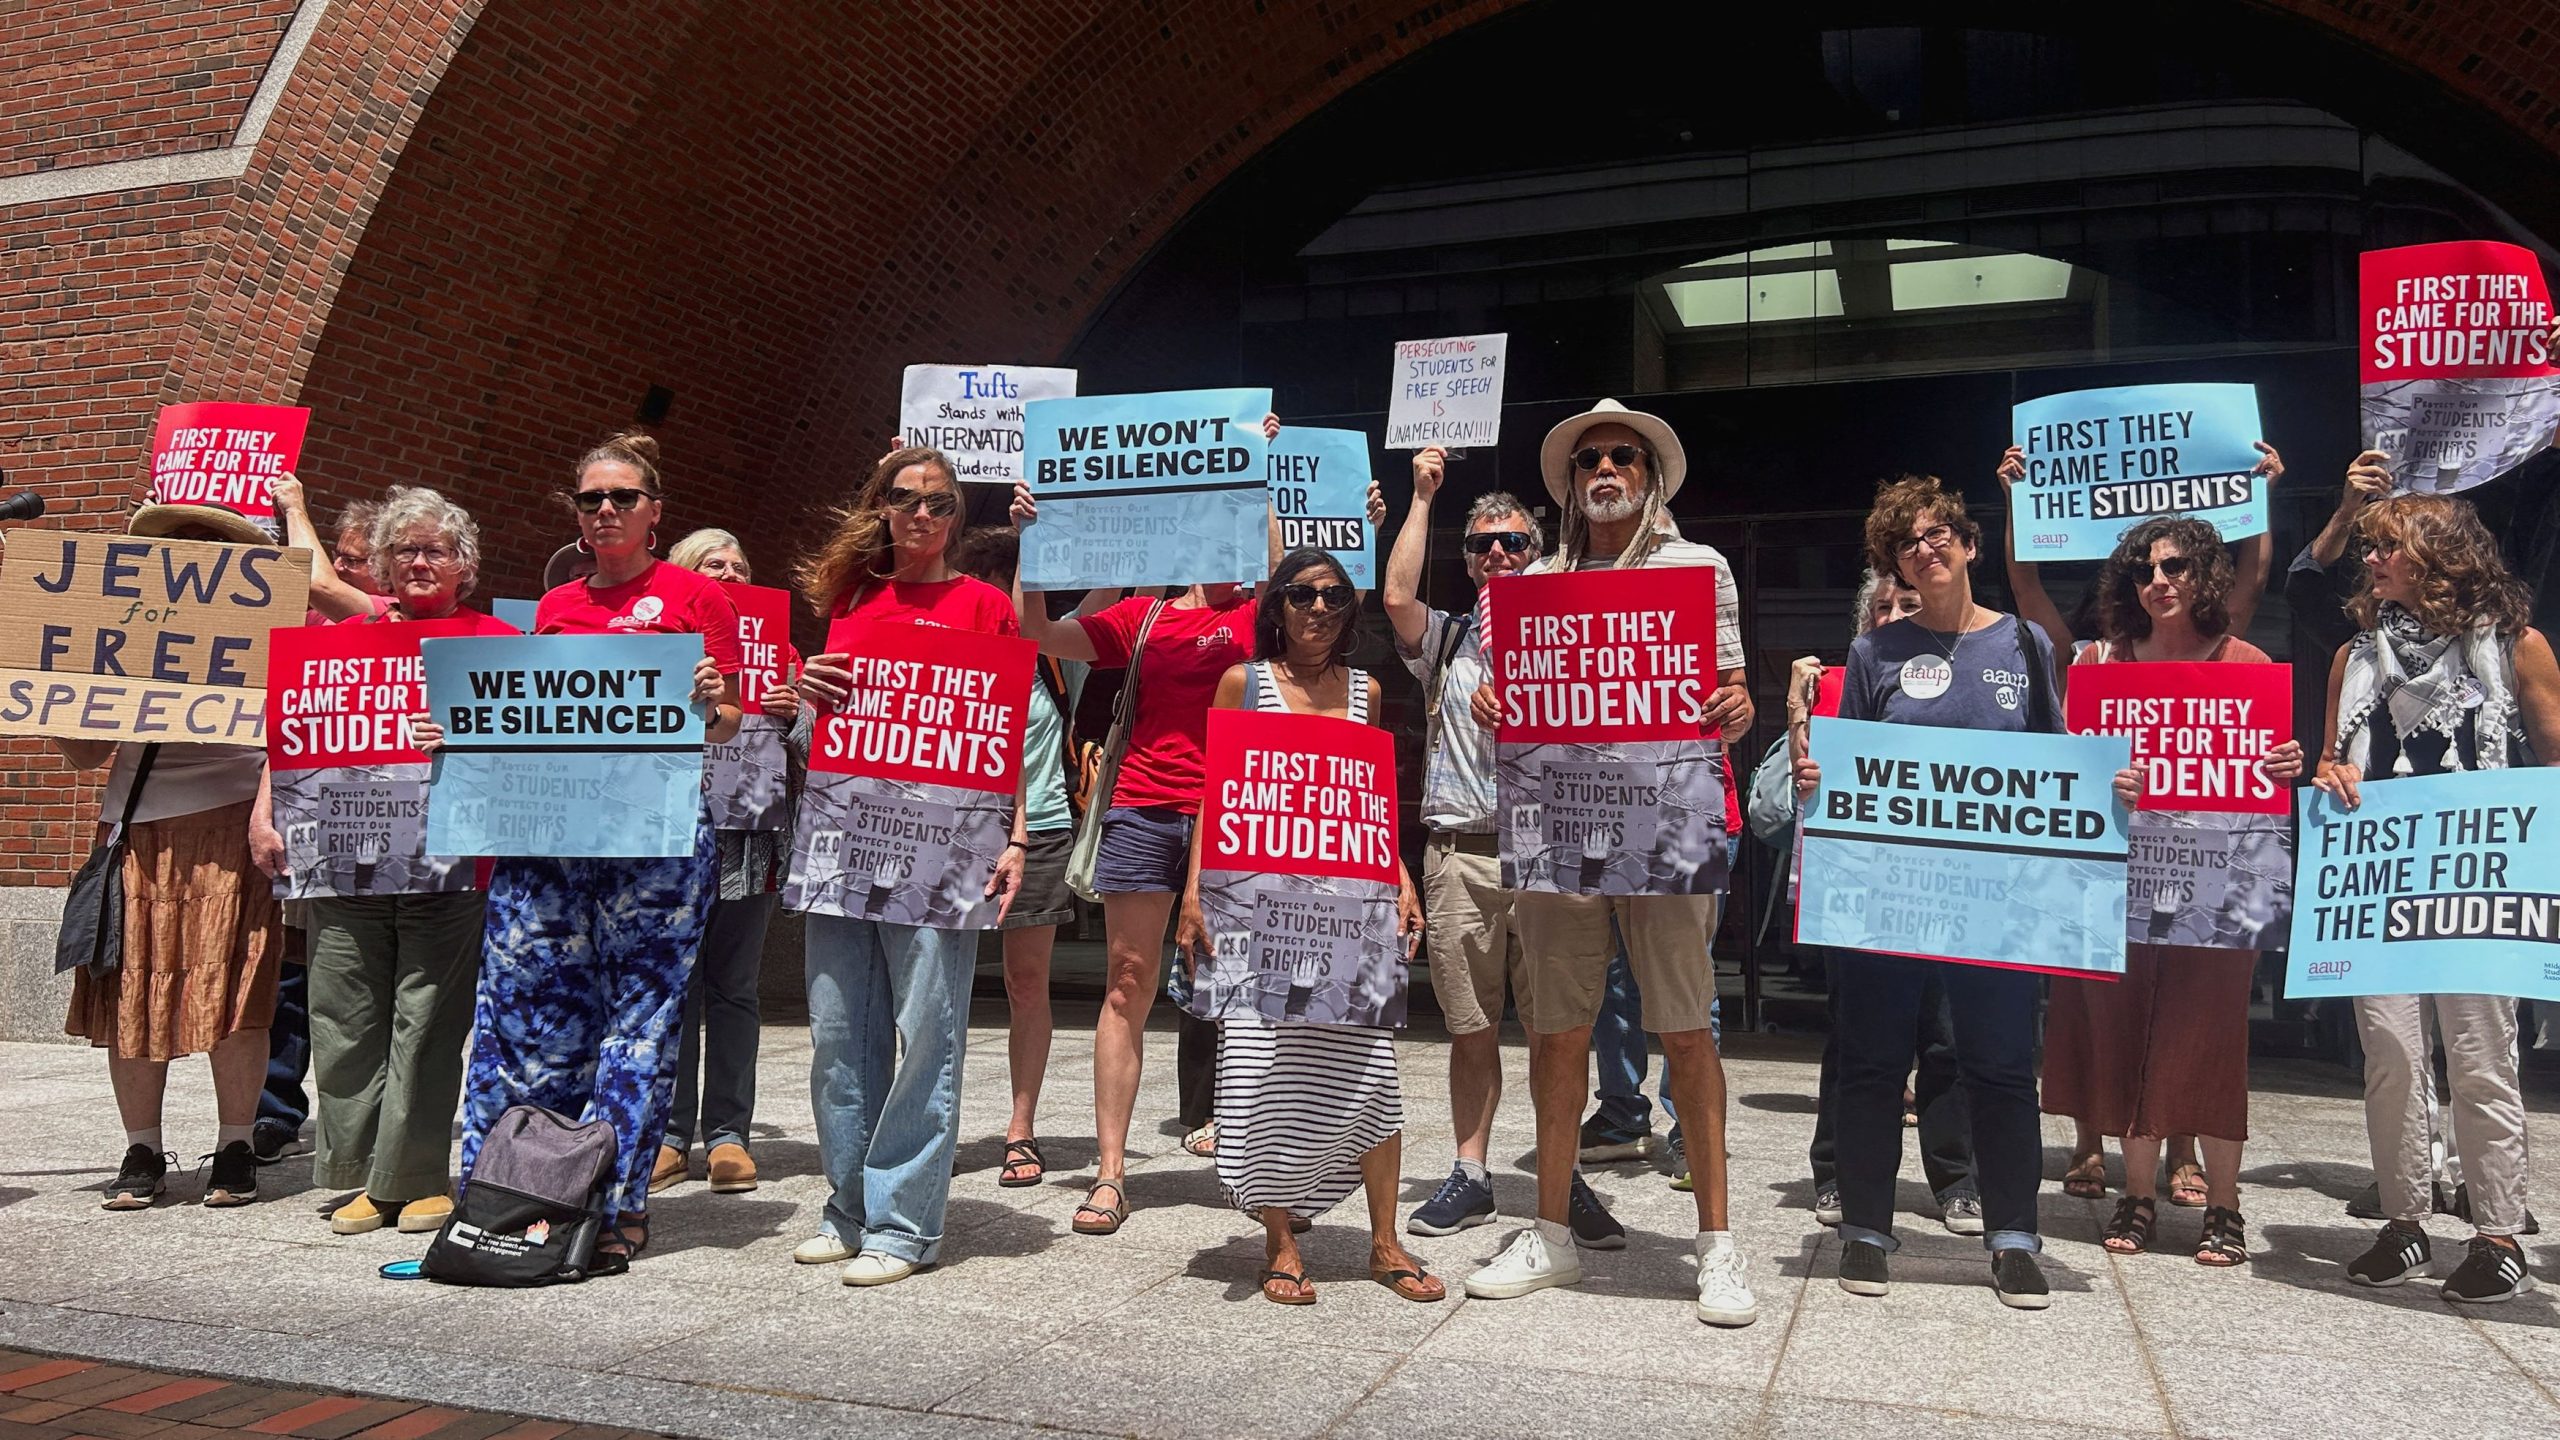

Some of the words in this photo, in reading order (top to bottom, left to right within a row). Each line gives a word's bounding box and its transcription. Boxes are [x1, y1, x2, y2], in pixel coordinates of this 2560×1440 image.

[2397, 275, 2470, 304] FIRST
[2477, 275, 2528, 300] THEY
[2376, 303, 2446, 332] CAME
[2455, 302, 2500, 327] FOR
[2508, 302, 2549, 326] THE
[1400, 341, 1477, 360] PERSECUTING
[2374, 329, 2548, 370] STUDENTS
[1410, 359, 1474, 379] STUDENTS
[1481, 356, 1497, 370] FOR
[959, 372, 1019, 399] Tufts
[1407, 383, 1439, 400] FREE
[1446, 376, 1492, 398] SPEECH
[997, 406, 1025, 422] with
[1433, 400, 1445, 417] IS
[2422, 412, 2507, 428] STUDENTS
[170, 428, 221, 449] FIRST
[226, 429, 276, 451] THEY
[906, 427, 1025, 454] INTERNATIO
[1058, 425, 1109, 452] WE
[1116, 418, 1230, 448] WON'T
[2029, 418, 2109, 454] FIRST
[2119, 411, 2194, 444] THEY
[156, 450, 199, 473] CAME
[201, 450, 241, 471] FOR
[248, 453, 285, 474] THE
[954, 457, 1011, 477] tudents
[1038, 457, 1076, 484] BE
[1084, 447, 1250, 482] SILENCED
[1268, 454, 1320, 483] THEY
[2029, 454, 2110, 488] CAME
[2121, 447, 2180, 479] FOR
[154, 472, 279, 507] STUDENTS
[2030, 490, 2084, 520] THE
[2094, 474, 2249, 517] STUDENTS
[1086, 516, 1178, 536] STUDENTS
[1277, 520, 1361, 548] DENTS
[2033, 534, 2069, 548] aaup
[33, 540, 283, 607] JEWS
[119, 601, 178, 624] for
[1520, 613, 1594, 647] FIRST
[1602, 610, 1676, 644] THEY
[40, 624, 253, 687] FREE
[741, 642, 778, 668] THE
[1505, 649, 1570, 681] CAME
[1580, 646, 1636, 679] FOR
[1646, 644, 1700, 676] THE
[303, 658, 375, 686] FIRST
[382, 656, 427, 683] THE
[468, 671, 526, 699] WE
[534, 669, 662, 699] WON'T
[852, 657, 925, 690] FIRST
[931, 665, 998, 700] THEY
[1904, 667, 1950, 686] aaup
[1983, 669, 2030, 695] aaup
[0, 680, 267, 738] SPEECH
[282, 687, 349, 715] CAME
[359, 685, 409, 711] FOR
[1505, 679, 1702, 728] STUDENTS
[1998, 692, 2017, 705] BU
[2101, 698, 2175, 725] FIRST
[2183, 699, 2252, 726] THEY
[450, 706, 494, 735] BE
[501, 705, 686, 735] SILENCED
[902, 693, 955, 726] FOR
[965, 701, 1013, 734] THE
[281, 713, 416, 756] STUDEN
[824, 717, 1009, 777] STUDENTS
[2160, 727, 2213, 755] FOR
[2223, 728, 2274, 756] THE
[1245, 750, 1320, 782] FIRST
[1327, 756, 1376, 790] THEY
[1543, 765, 1593, 781] PROTECT
[1599, 771, 1624, 781] OUR
[1855, 757, 1920, 791] WE
[1930, 763, 2079, 802] WON'T
[2137, 758, 2275, 800] DENTS
[321, 787, 365, 799] PROTECT
[371, 789, 393, 798] OUR
[502, 774, 601, 800] STUDENTS
[1554, 783, 1658, 807] STUDENTS
[330, 800, 420, 818] STUDENTS
[851, 796, 895, 815] PROTECT
[901, 807, 924, 818] OUR
[1222, 779, 1295, 813] CAME
[1304, 785, 1351, 817] FOR
[1358, 791, 1390, 825] THE
[1544, 803, 1593, 818] PROTECT
[1598, 809, 1625, 819] OUR
[1827, 790, 1879, 823] BE
[1888, 796, 2105, 840] SILENCED
[320, 819, 365, 830] PROTECT
[370, 821, 392, 830] OUR
[857, 814, 952, 846] STUDENTS
[2321, 814, 2423, 858] FIRST
[2435, 806, 2538, 846] THEY
[844, 831, 891, 850] PROTECT
[894, 842, 917, 853] OUR
[1218, 812, 1391, 868] STUDENTS
[2173, 835, 2197, 845] OUR
[2129, 843, 2228, 869] STUDENTS
[1886, 865, 2008, 902] STUDENTS
[2170, 868, 2195, 878] OUR
[2318, 857, 2415, 900] CAME
[2429, 852, 2508, 891] FOR
[1257, 894, 1308, 911] PROTECT
[1313, 902, 1336, 913] OUR
[1267, 910, 1362, 940] STUDENTS
[2314, 903, 2377, 942] THE
[1254, 931, 1306, 946] PROTECT
[1310, 939, 1333, 949] OUR
[2309, 961, 2352, 980] aaup
